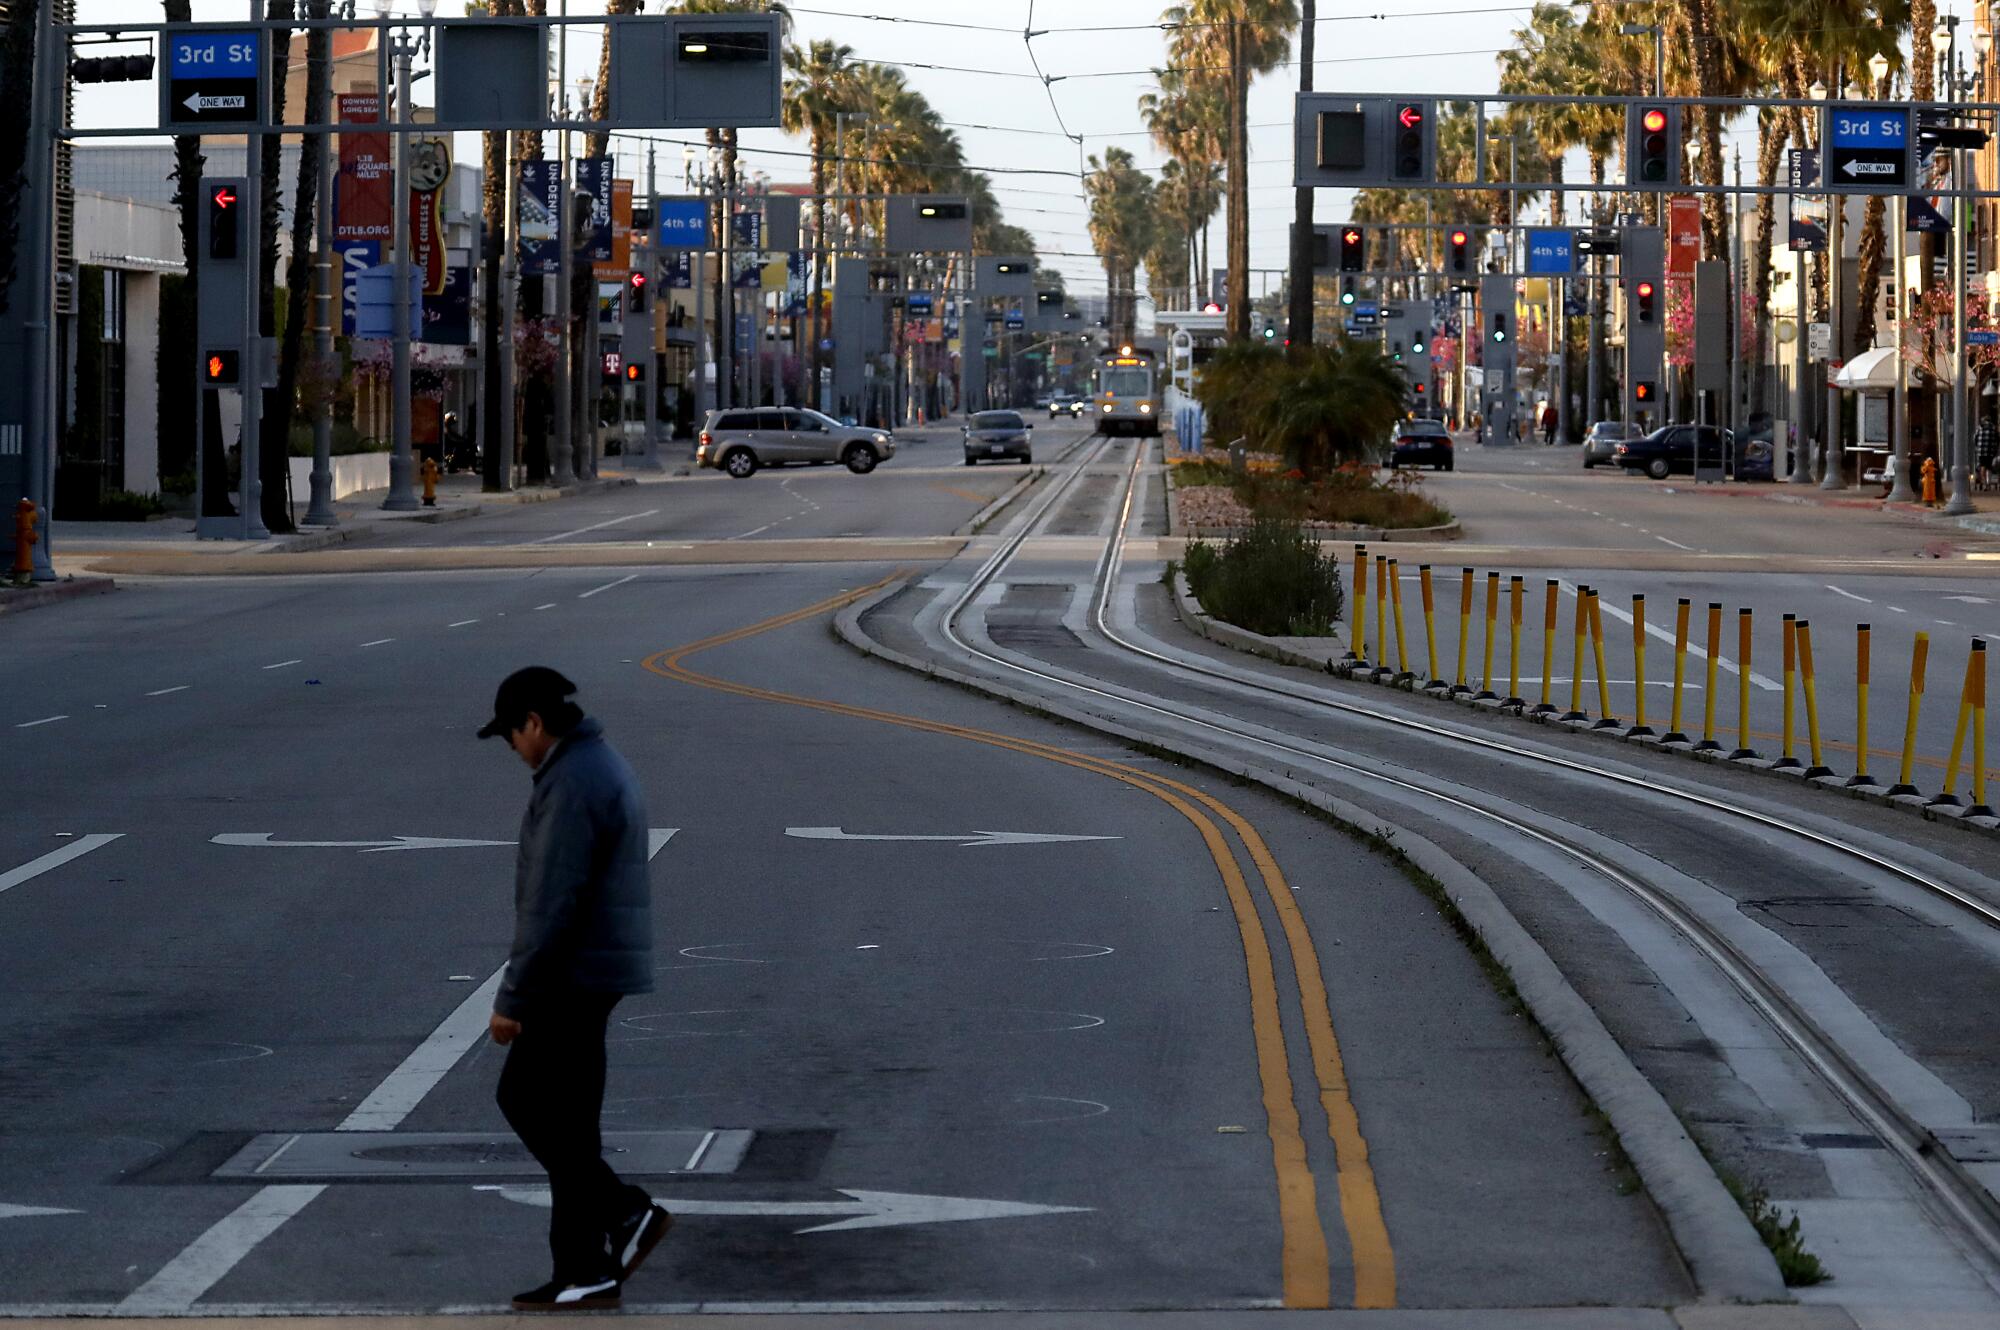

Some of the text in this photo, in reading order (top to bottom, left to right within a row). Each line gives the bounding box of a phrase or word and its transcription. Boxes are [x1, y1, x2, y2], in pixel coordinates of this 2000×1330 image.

[179, 44, 253, 63] 3rd St
[200, 97, 242, 107] ONE WAY
[1839, 119, 1902, 137] 3rd St
[357, 162, 389, 171] SQUARE
[1857, 163, 1894, 173] ONE WAY
[357, 171, 380, 179] MILES
[599, 161, 610, 219] UN-TAPPED
[663, 217, 703, 229] 4th St
[338, 225, 390, 236] DTLB.ORG
[1533, 246, 1569, 256] 4th St
[606, 353, 620, 374] T
